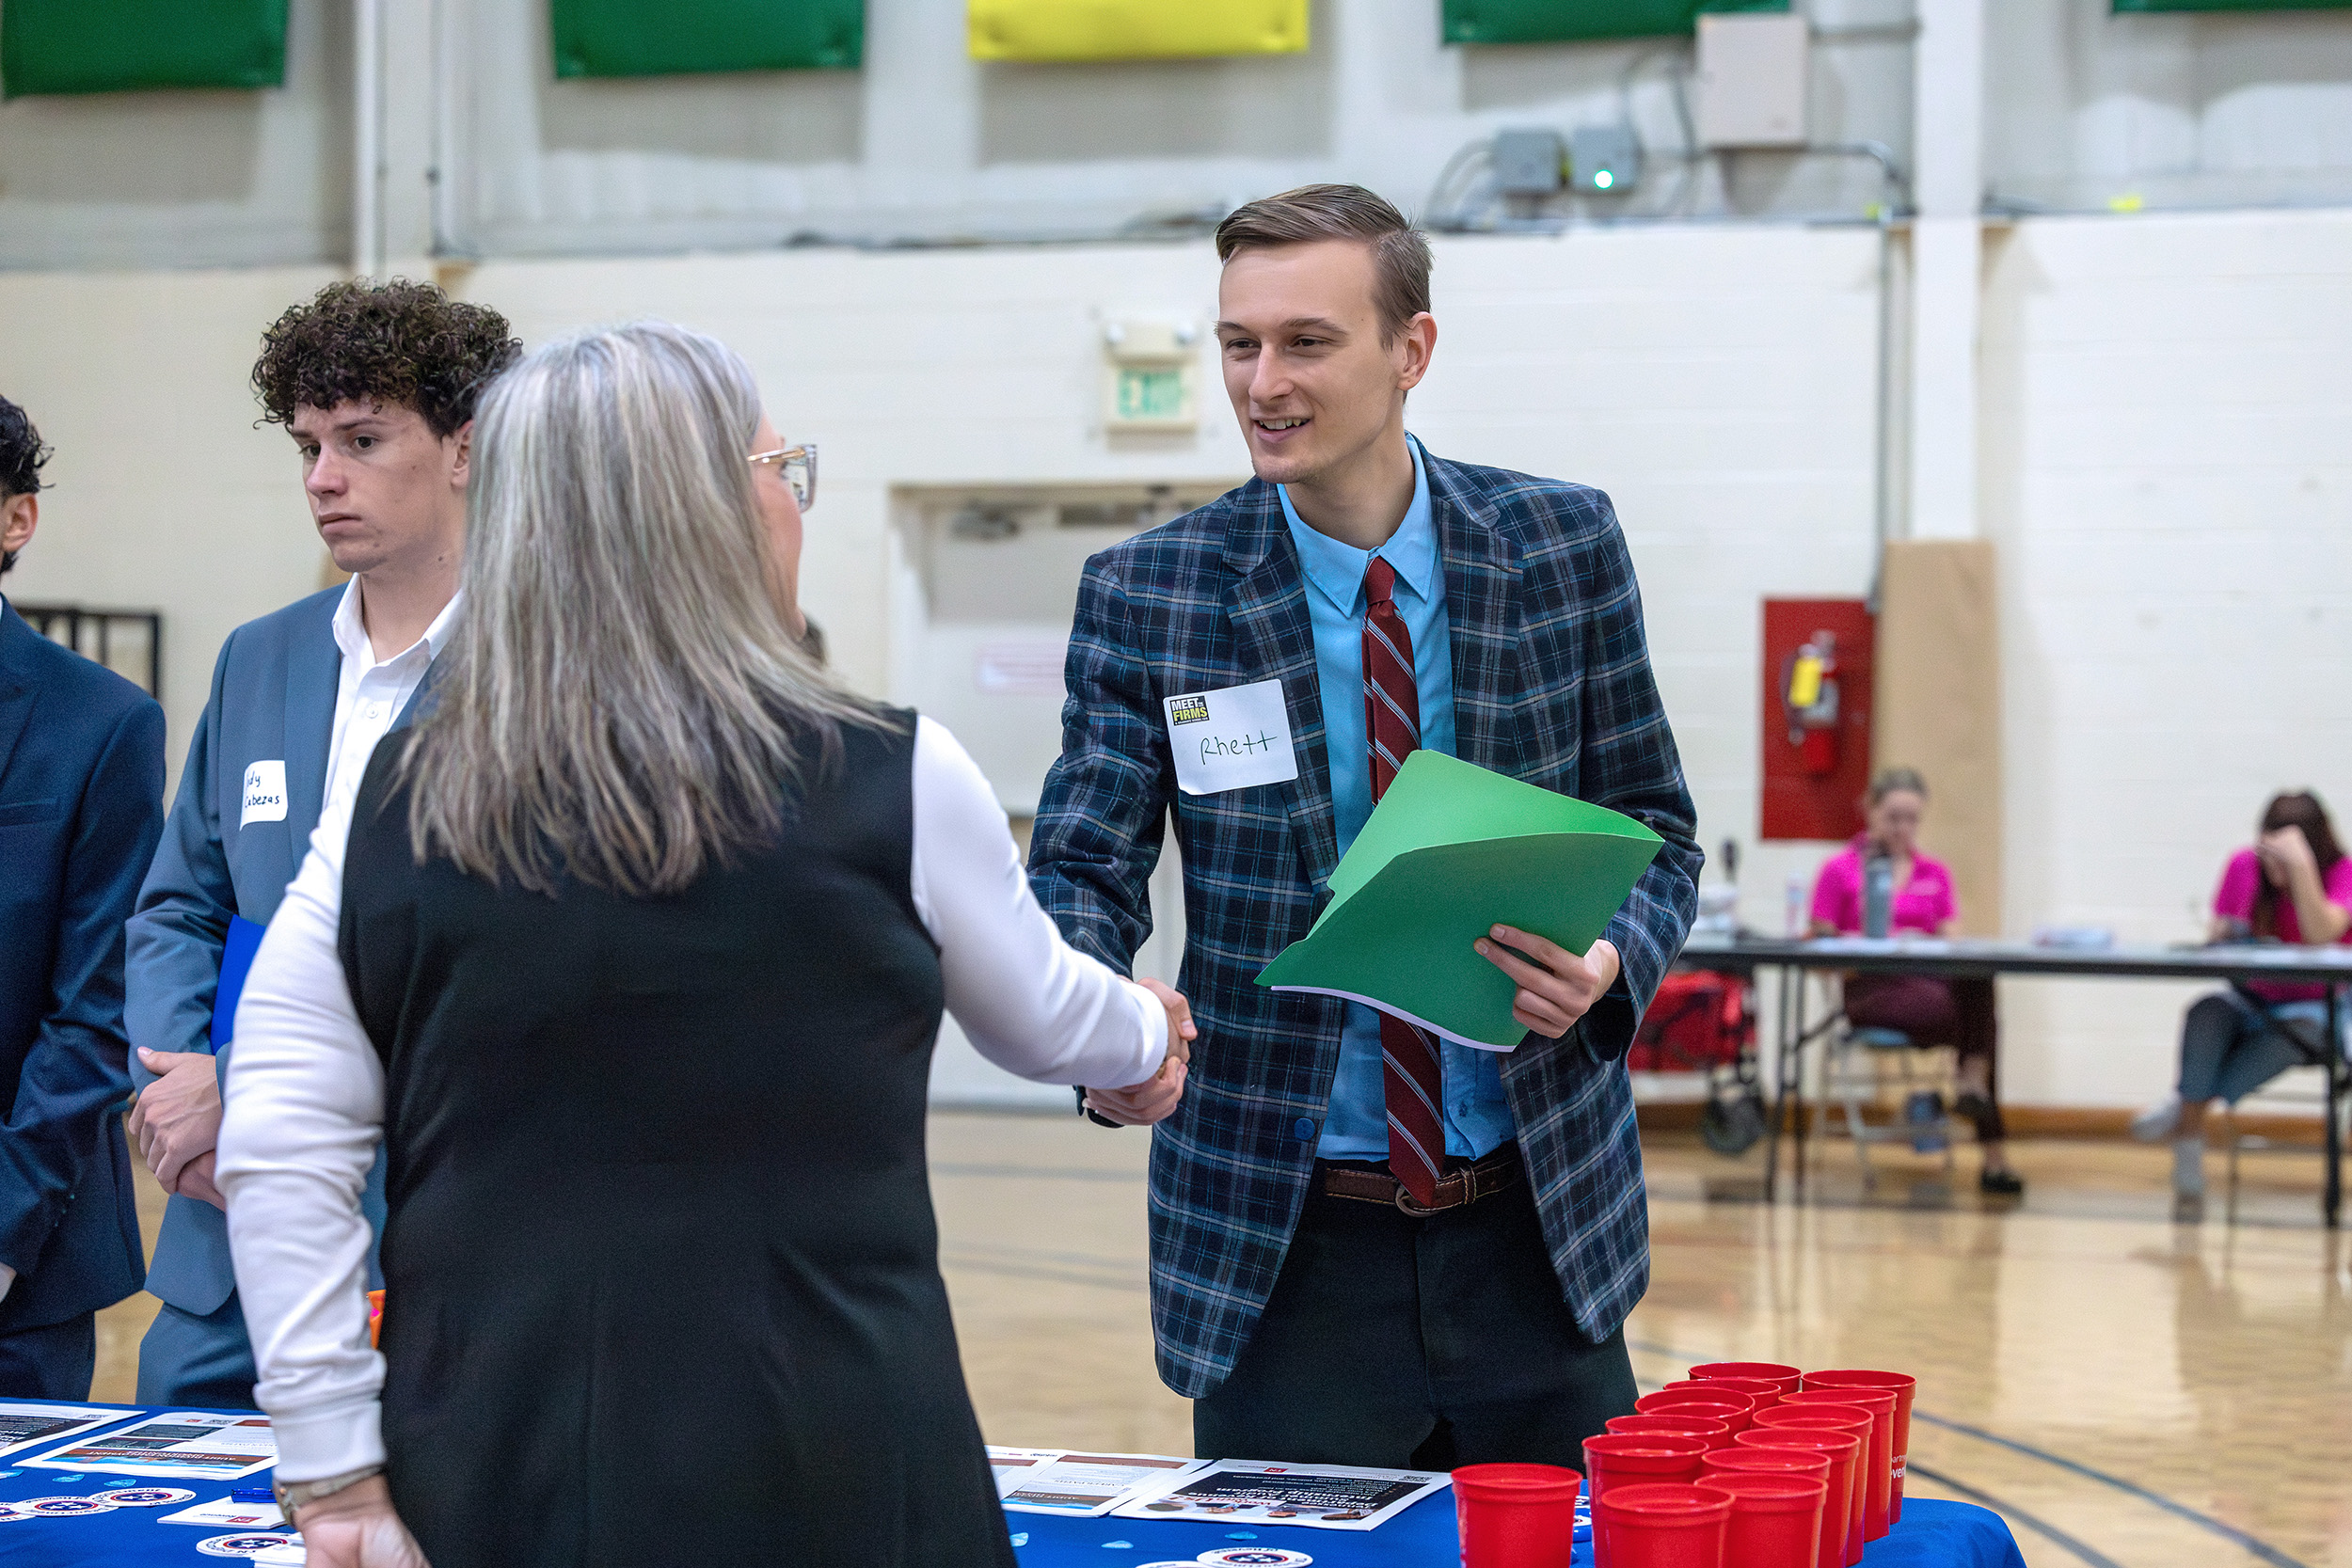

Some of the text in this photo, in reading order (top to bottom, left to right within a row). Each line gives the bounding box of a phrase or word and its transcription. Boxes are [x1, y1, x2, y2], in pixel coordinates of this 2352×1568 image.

[1171, 697, 1200, 711] MEET
[1172, 706, 1208, 721] FIRMS
[1200, 730, 1278, 765] Rhett
